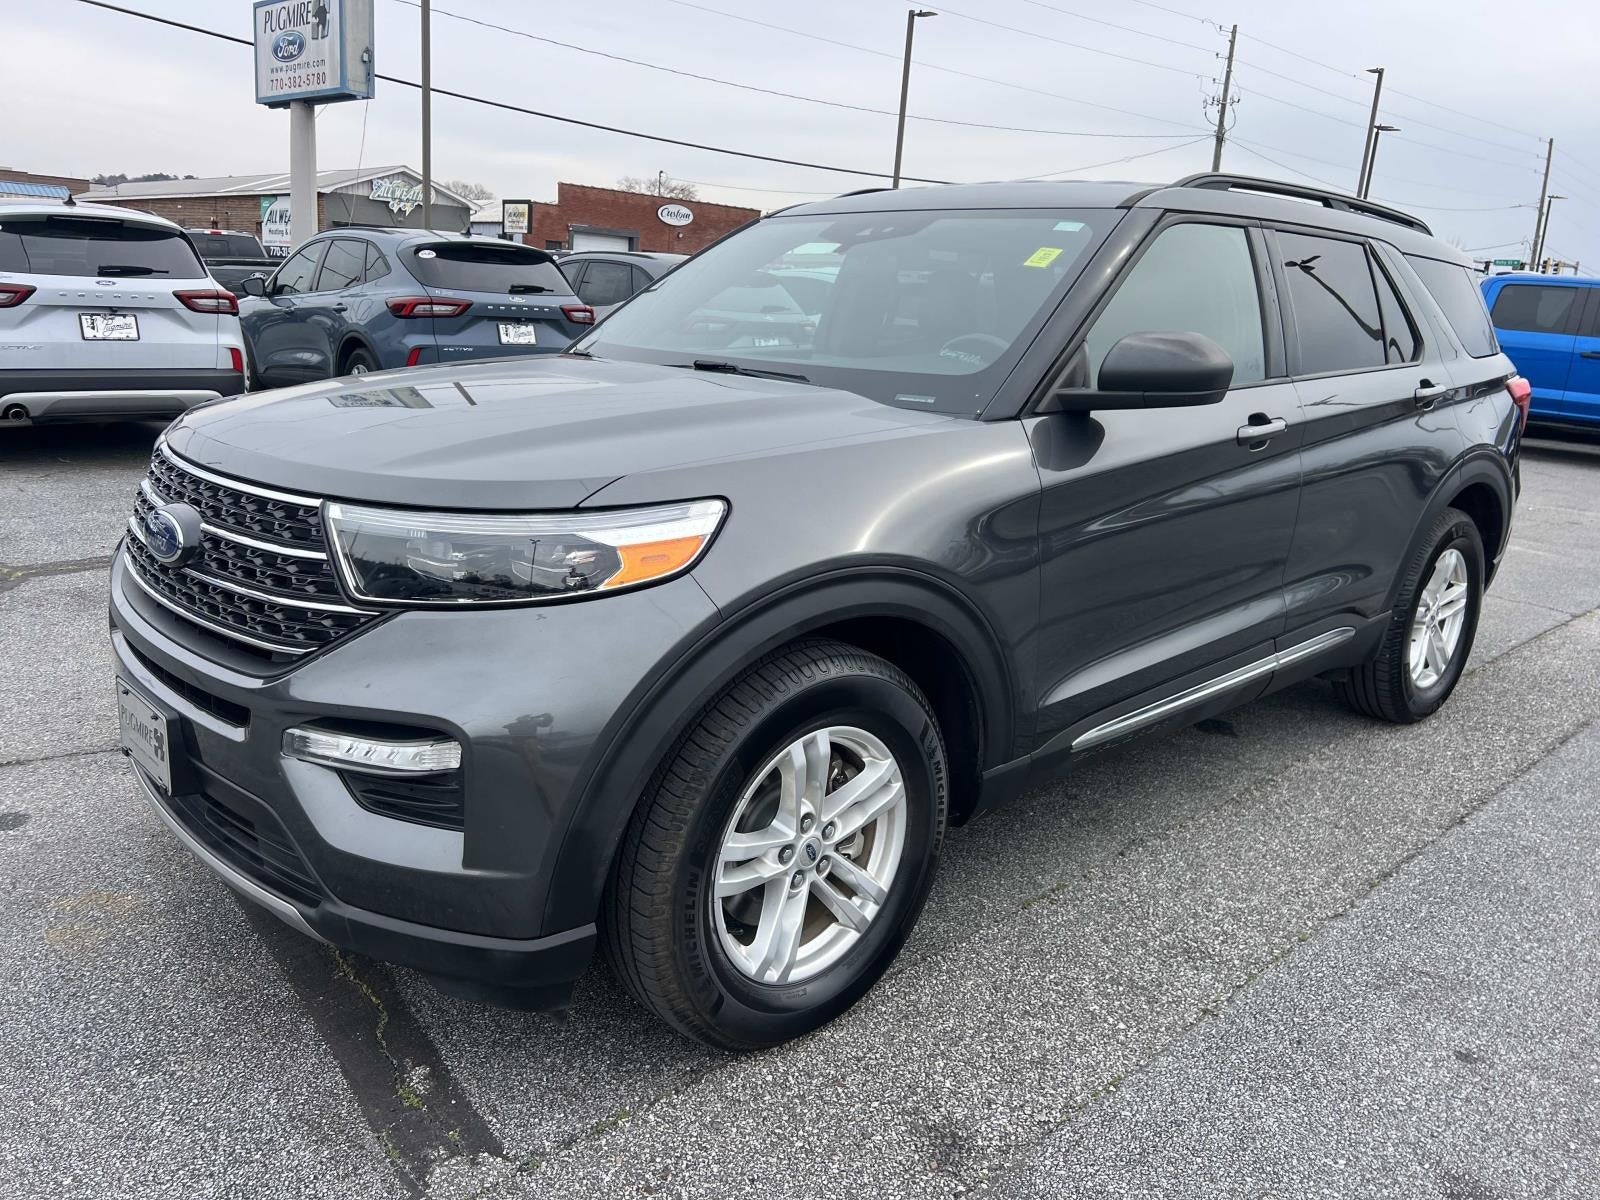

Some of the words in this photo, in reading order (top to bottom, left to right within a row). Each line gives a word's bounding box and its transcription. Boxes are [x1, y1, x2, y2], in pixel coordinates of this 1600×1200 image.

[264, 1, 312, 34] PUGMIRE
[277, 36, 299, 57] Ford
[270, 59, 326, 75] www.pugmire.com
[270, 72, 327, 91] 770-382-5780
[265, 209, 278, 226] ALL
[661, 207, 691, 219] Custom
[120, 703, 154, 748] PUGMIRE
[684, 871, 704, 979] MICHELIN
